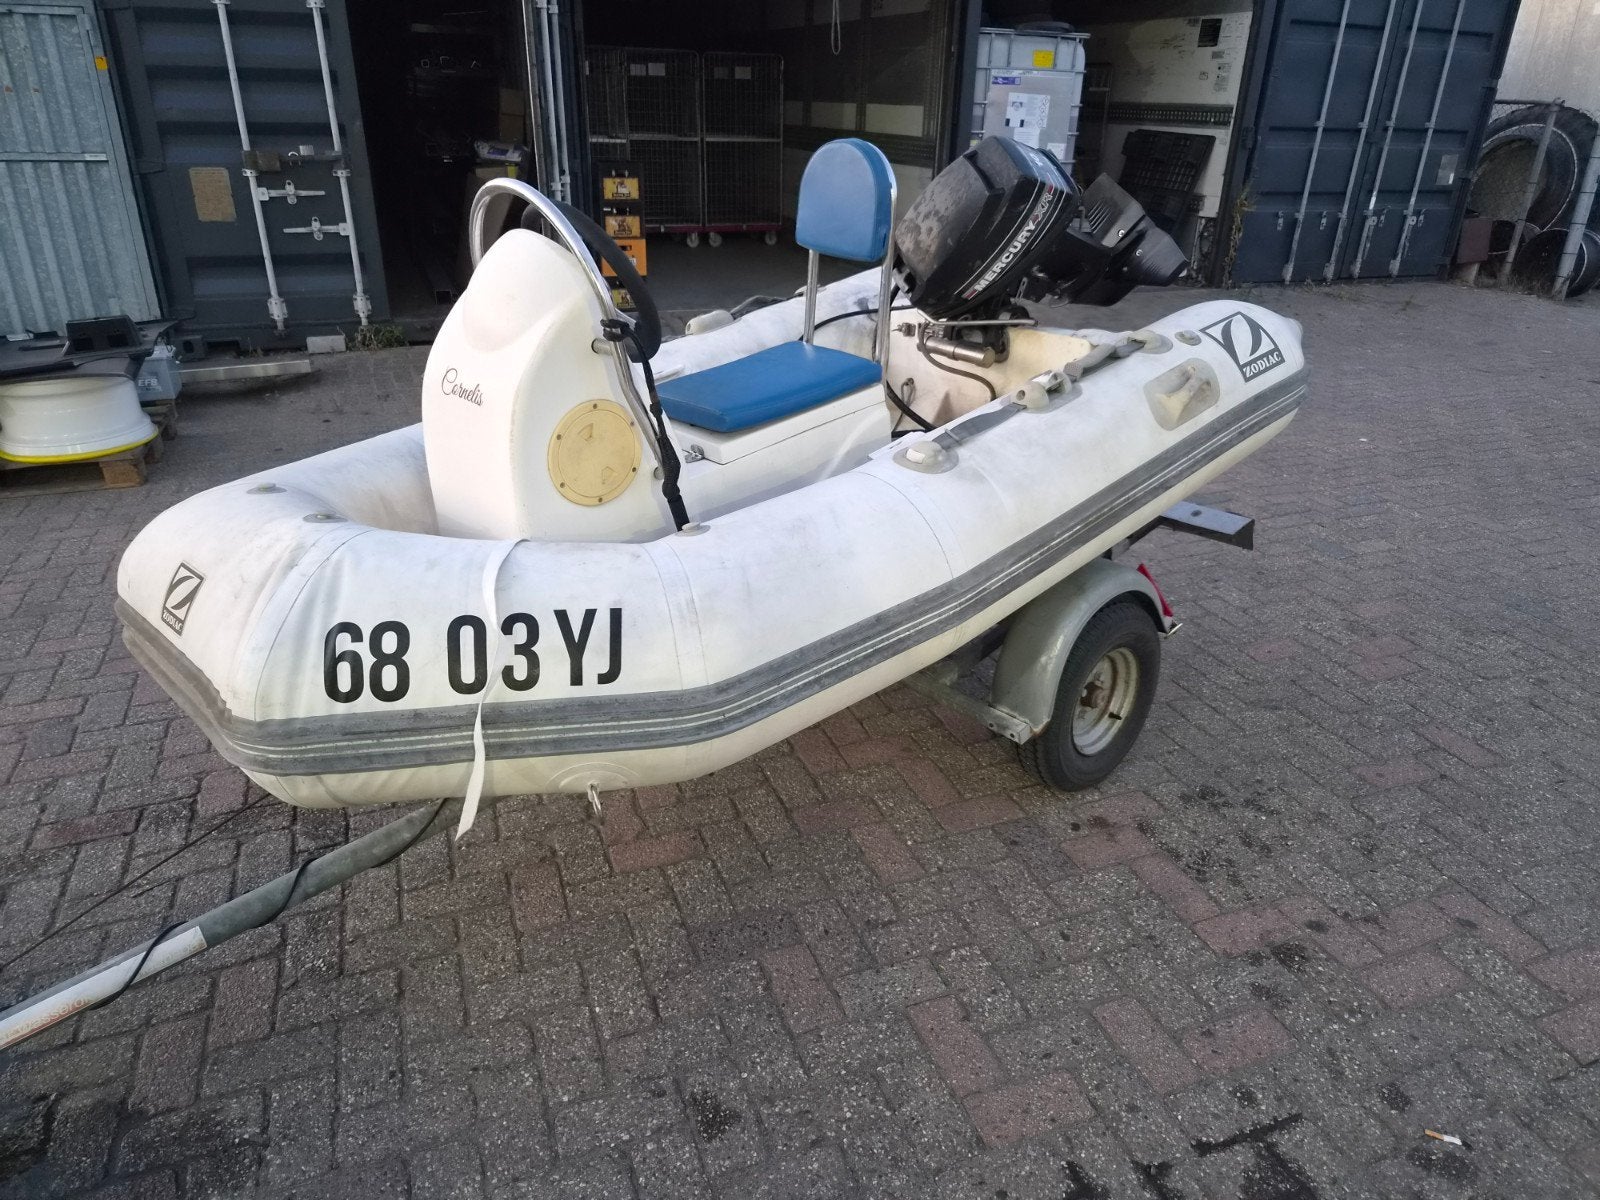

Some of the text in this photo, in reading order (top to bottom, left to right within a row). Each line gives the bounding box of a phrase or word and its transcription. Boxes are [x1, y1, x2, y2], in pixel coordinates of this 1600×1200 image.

[974, 220, 1035, 291] MERCURY
[1243, 351, 1281, 378] ZODIAC
[441, 367, 483, 406] Cornelis
[163, 610, 183, 631] ZODIAC
[324, 620, 410, 703] 68
